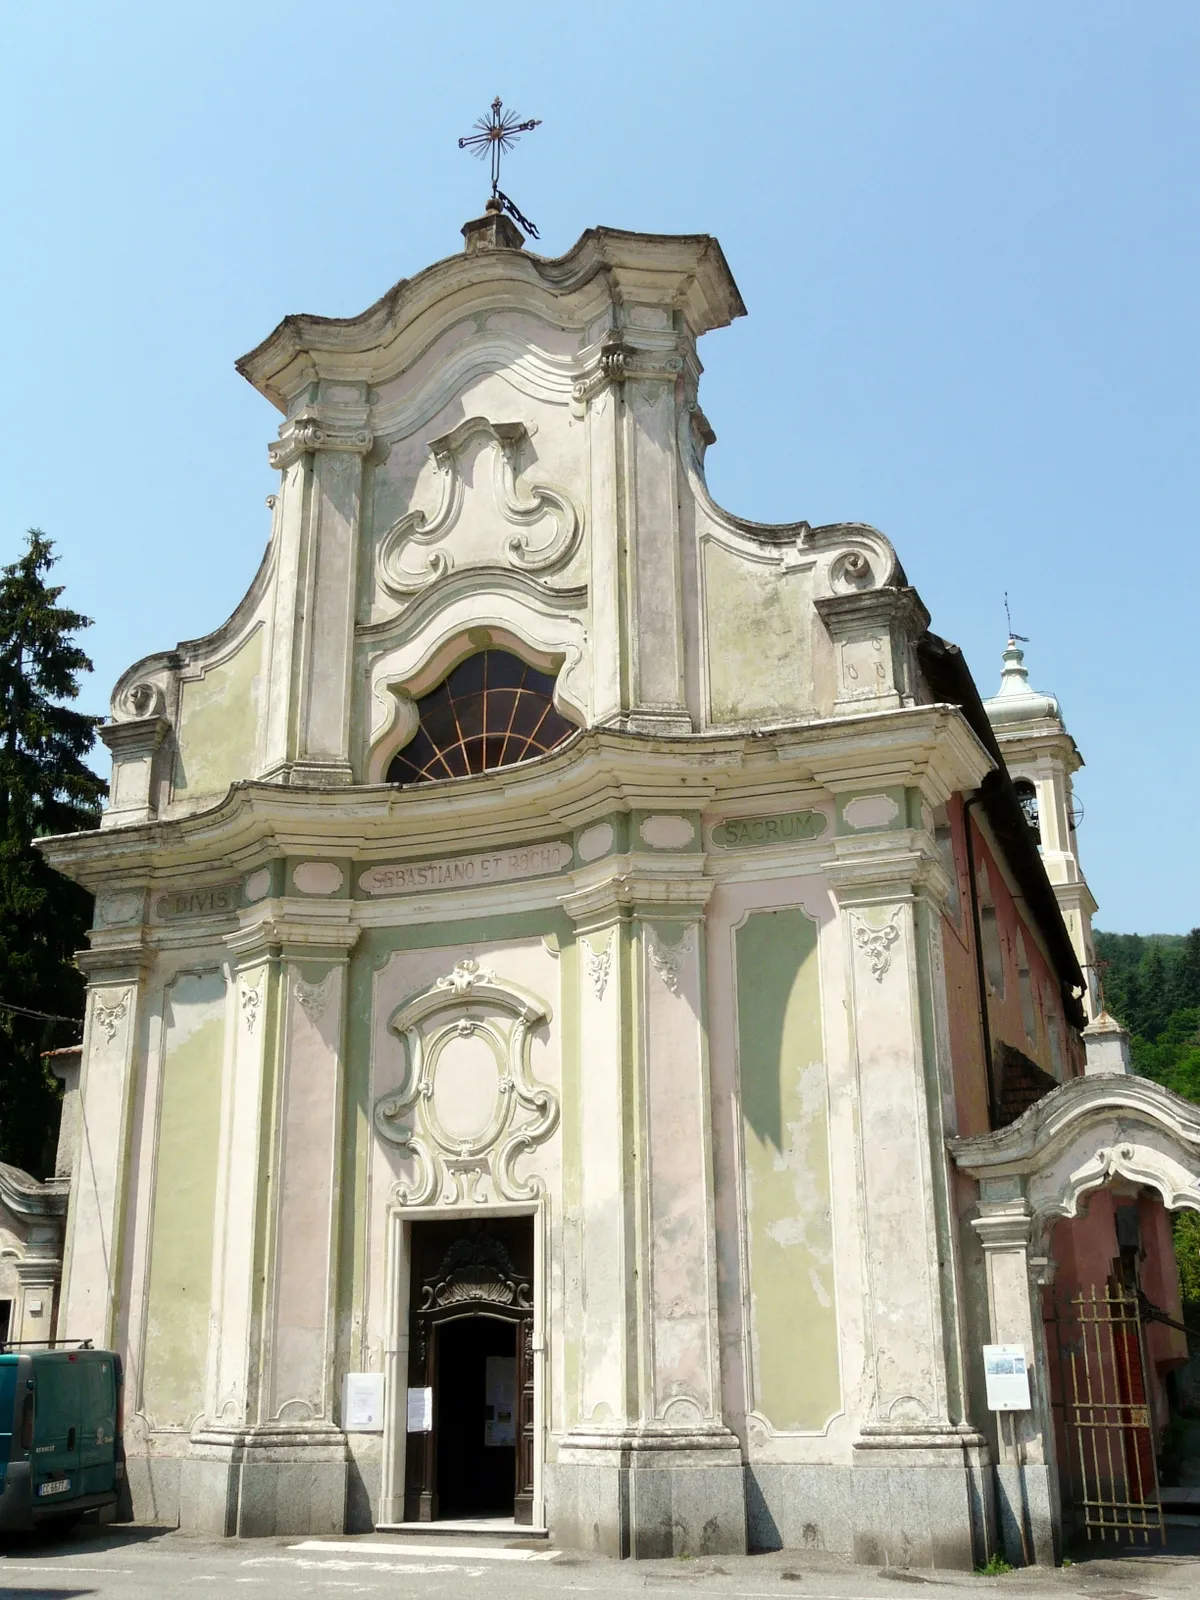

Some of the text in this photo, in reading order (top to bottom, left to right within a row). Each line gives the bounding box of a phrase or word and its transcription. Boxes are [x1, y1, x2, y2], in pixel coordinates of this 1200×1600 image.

[725, 816, 812, 843] SACRUM
[372, 848, 560, 889] SEBASTIANO ET ROCHO
[175, 892, 228, 913] DIVIS
